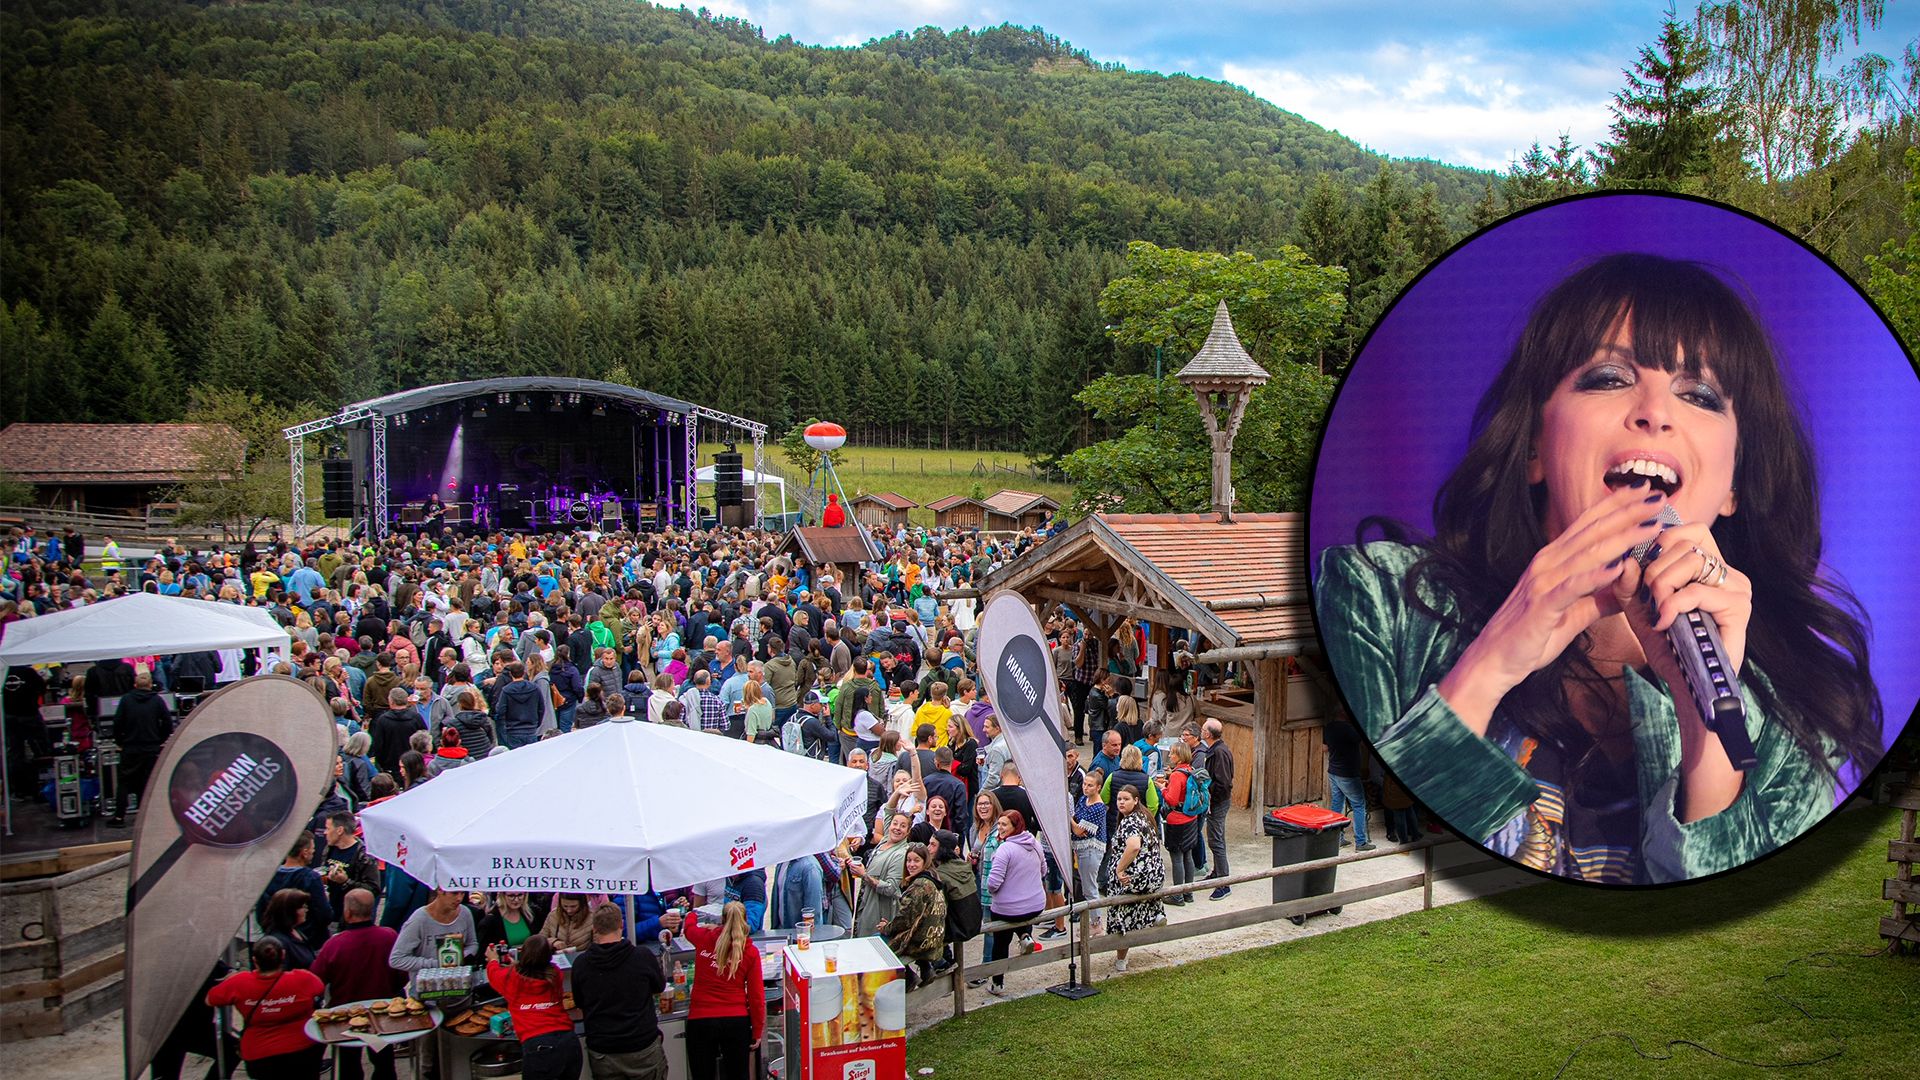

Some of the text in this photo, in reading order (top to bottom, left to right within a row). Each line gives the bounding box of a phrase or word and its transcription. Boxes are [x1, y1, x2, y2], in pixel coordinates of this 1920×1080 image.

[184, 753, 258, 825] HERMANN
[201, 757, 281, 836] FLEISCHLOS
[492, 857, 596, 871] BRAUKUNST
[729, 842, 757, 867] Stiegl
[448, 874, 639, 891] AUF HÖCHSTER STUFE
[820, 1048, 848, 1057] Braukunst
[859, 1043, 882, 1053] höchster
